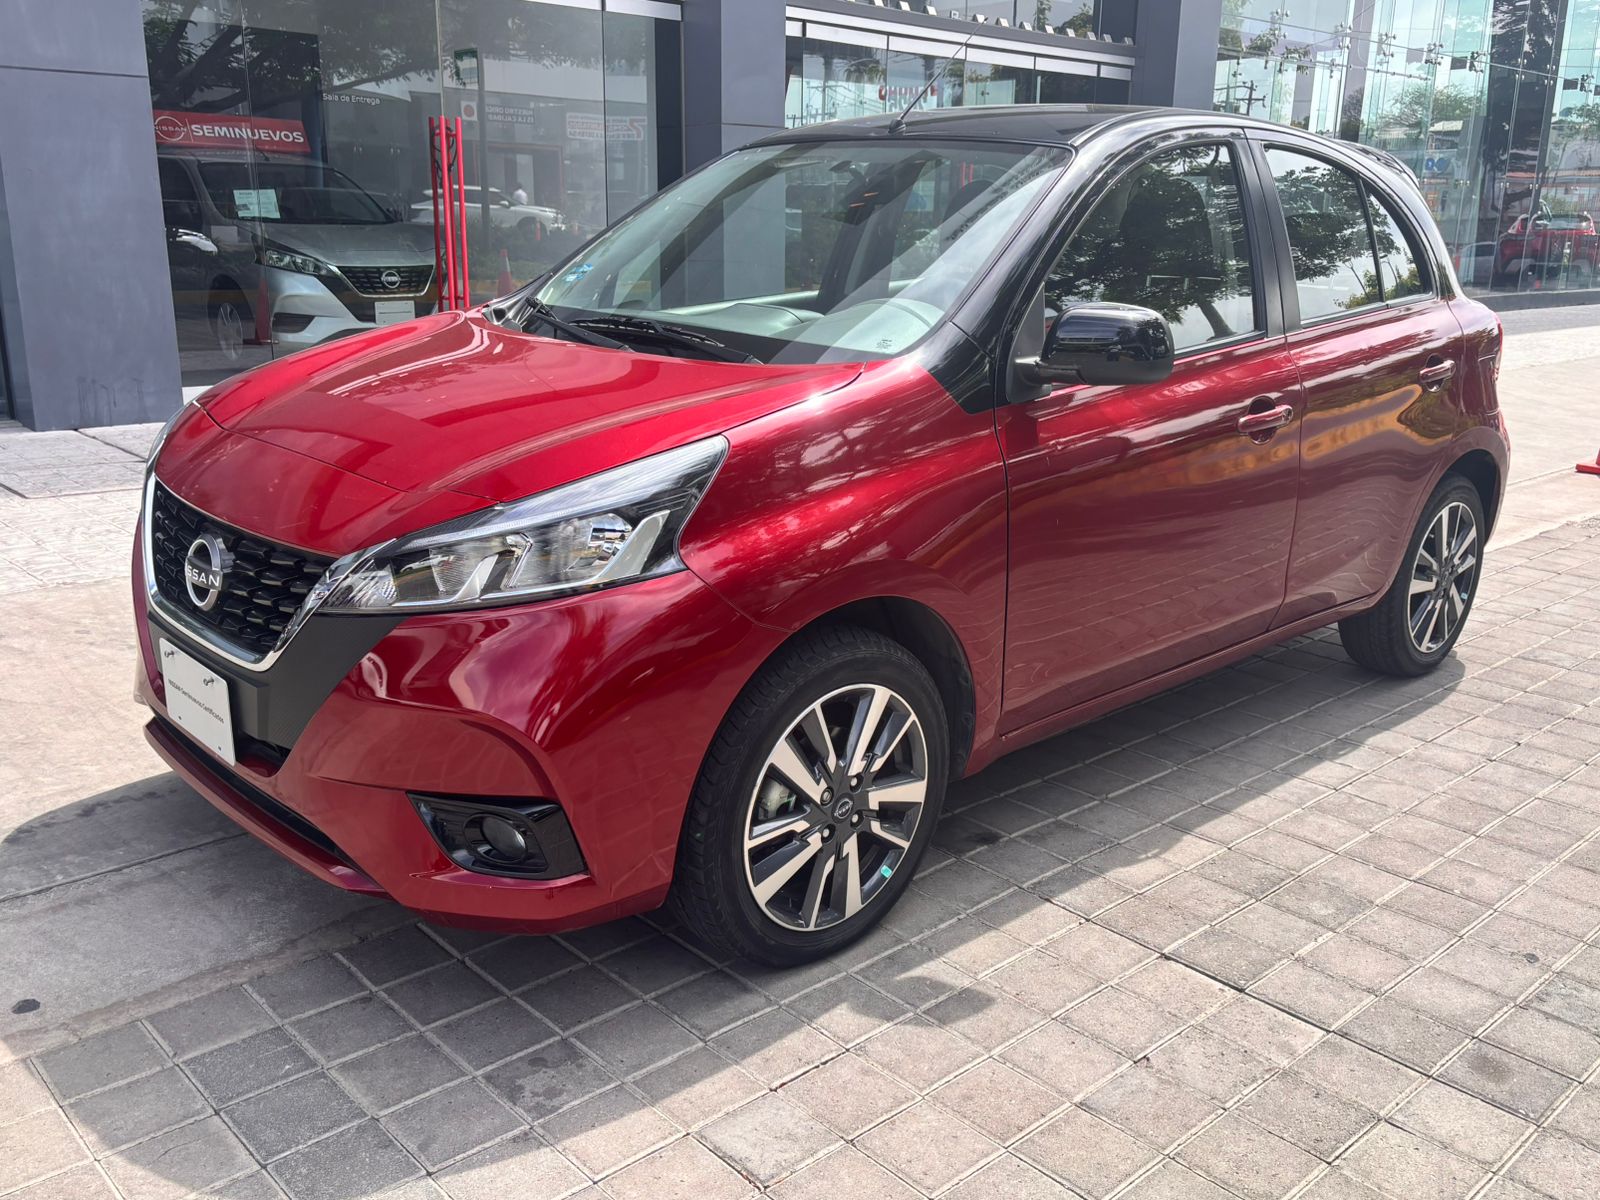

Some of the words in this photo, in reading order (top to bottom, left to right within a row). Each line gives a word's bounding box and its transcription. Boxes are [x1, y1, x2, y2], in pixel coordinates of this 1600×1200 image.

[322, 93, 339, 101] Sala
[351, 95, 381, 106] Entrega
[191, 124, 304, 143] SEMINUEVOS
[187, 565, 220, 587] SSAN
